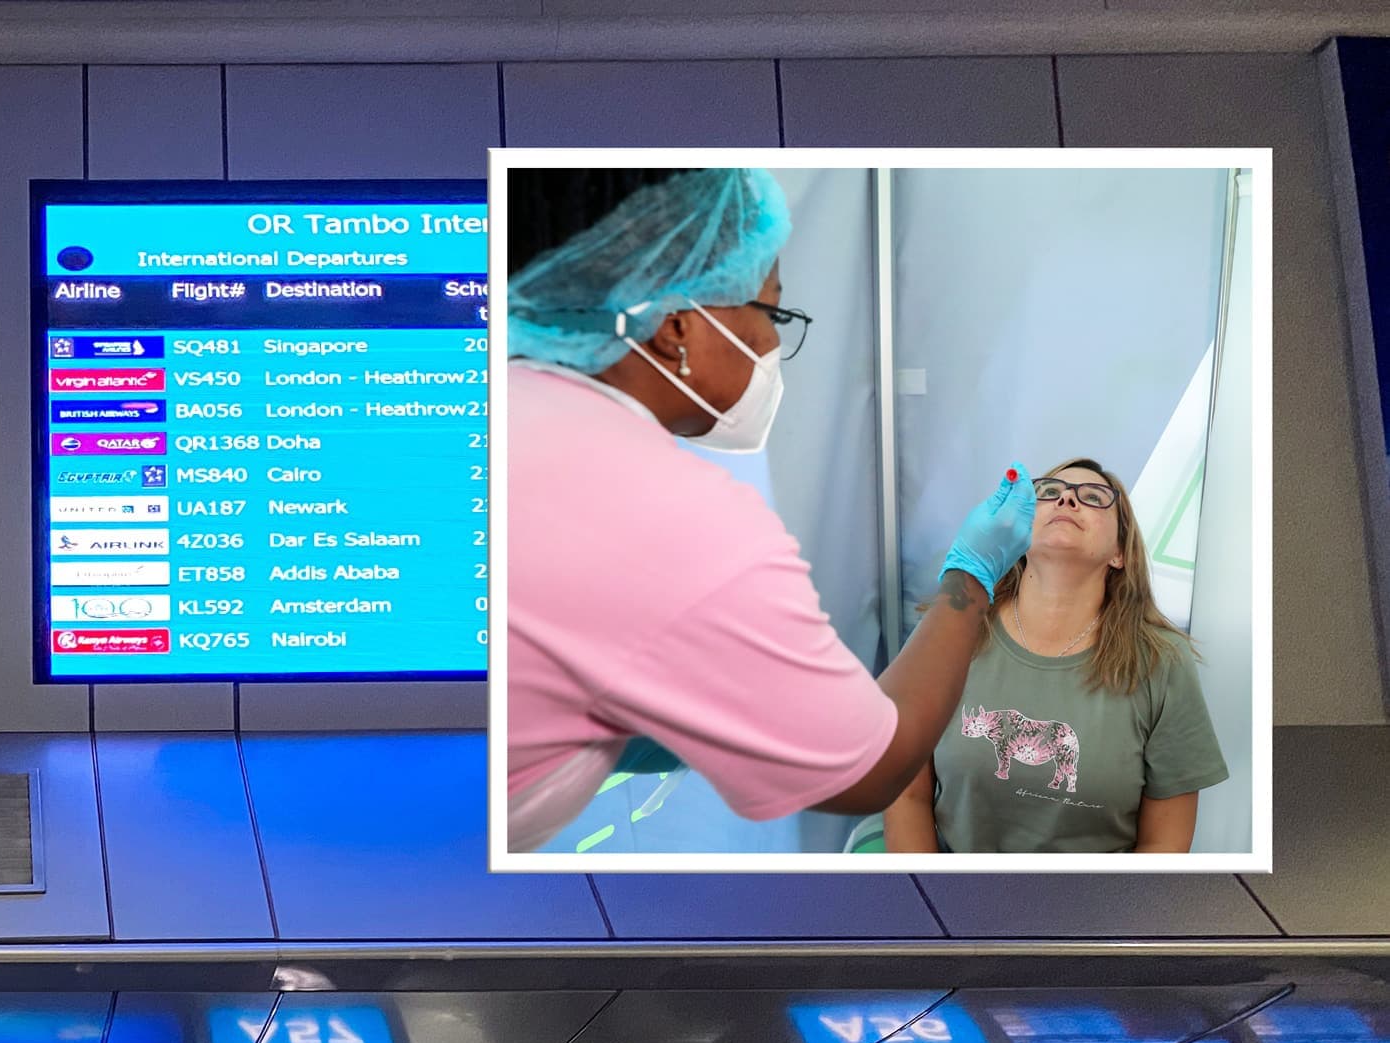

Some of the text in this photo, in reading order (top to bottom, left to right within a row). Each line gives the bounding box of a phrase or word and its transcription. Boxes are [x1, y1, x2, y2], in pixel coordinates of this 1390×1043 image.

[248, 214, 409, 234] OR Tambo
[138, 251, 407, 268] International Departures
[55, 282, 381, 300] Airline Flight# Destination
[174, 339, 368, 356] SQ481 Singapore
[174, 372, 241, 386] VS450
[266, 371, 341, 385] London
[365, 370, 464, 384] Heathrow
[176, 402, 466, 418] BA056 London Heathrow
[175, 436, 260, 453] QR1368
[267, 435, 321, 449] Doha
[177, 467, 321, 483] MS840 Cairo
[178, 499, 348, 515] UA187 Newark
[177, 534, 243, 548] 4Z036
[270, 533, 306, 547] Dar
[314, 533, 337, 547] Es
[345, 532, 420, 546] Salaam
[179, 565, 399, 581] ET858 Addis Ababa
[179, 598, 391, 614] KL592 Amsterdam
[180, 632, 346, 651] KQ765 Nairobi
